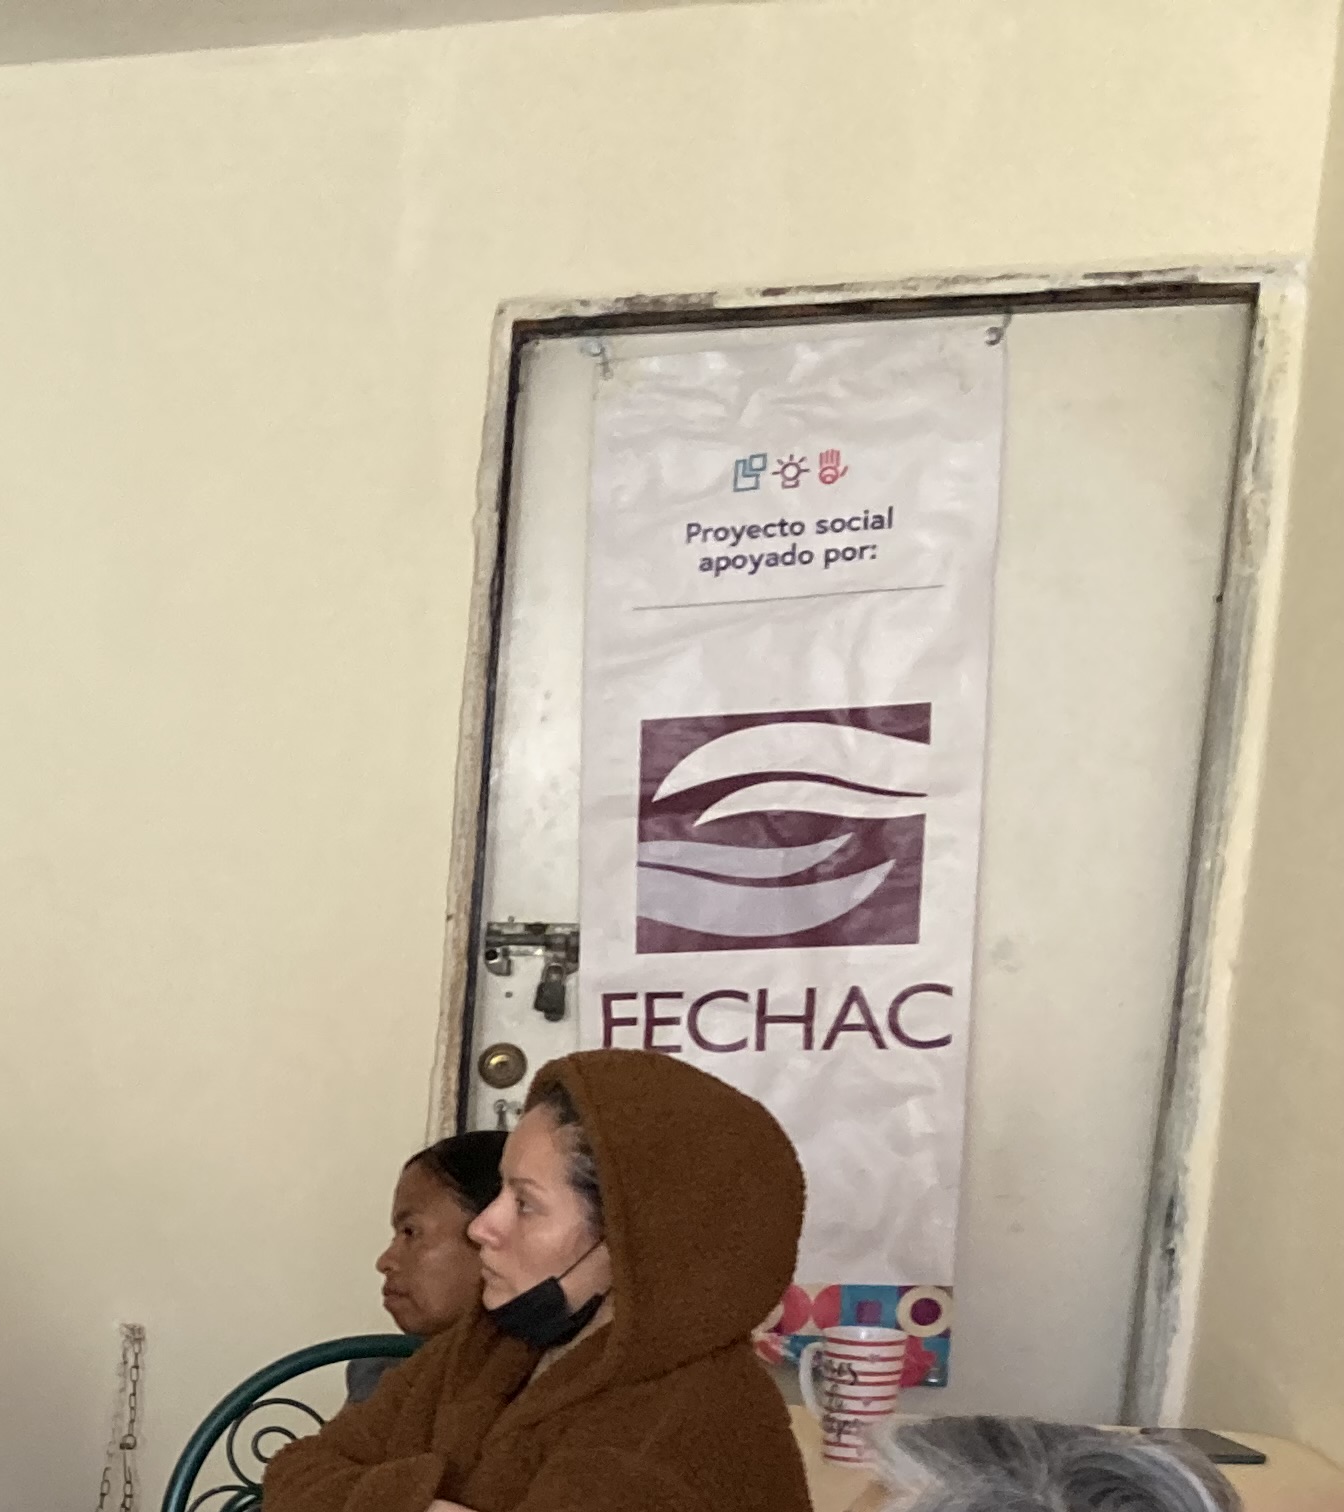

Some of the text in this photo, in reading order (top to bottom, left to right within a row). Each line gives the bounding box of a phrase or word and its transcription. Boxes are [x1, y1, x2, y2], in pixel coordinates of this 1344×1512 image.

[686, 505, 894, 547] Proyecto social
[699, 542, 878, 577] apoyado por:
[602, 983, 954, 1053] FECHAC
